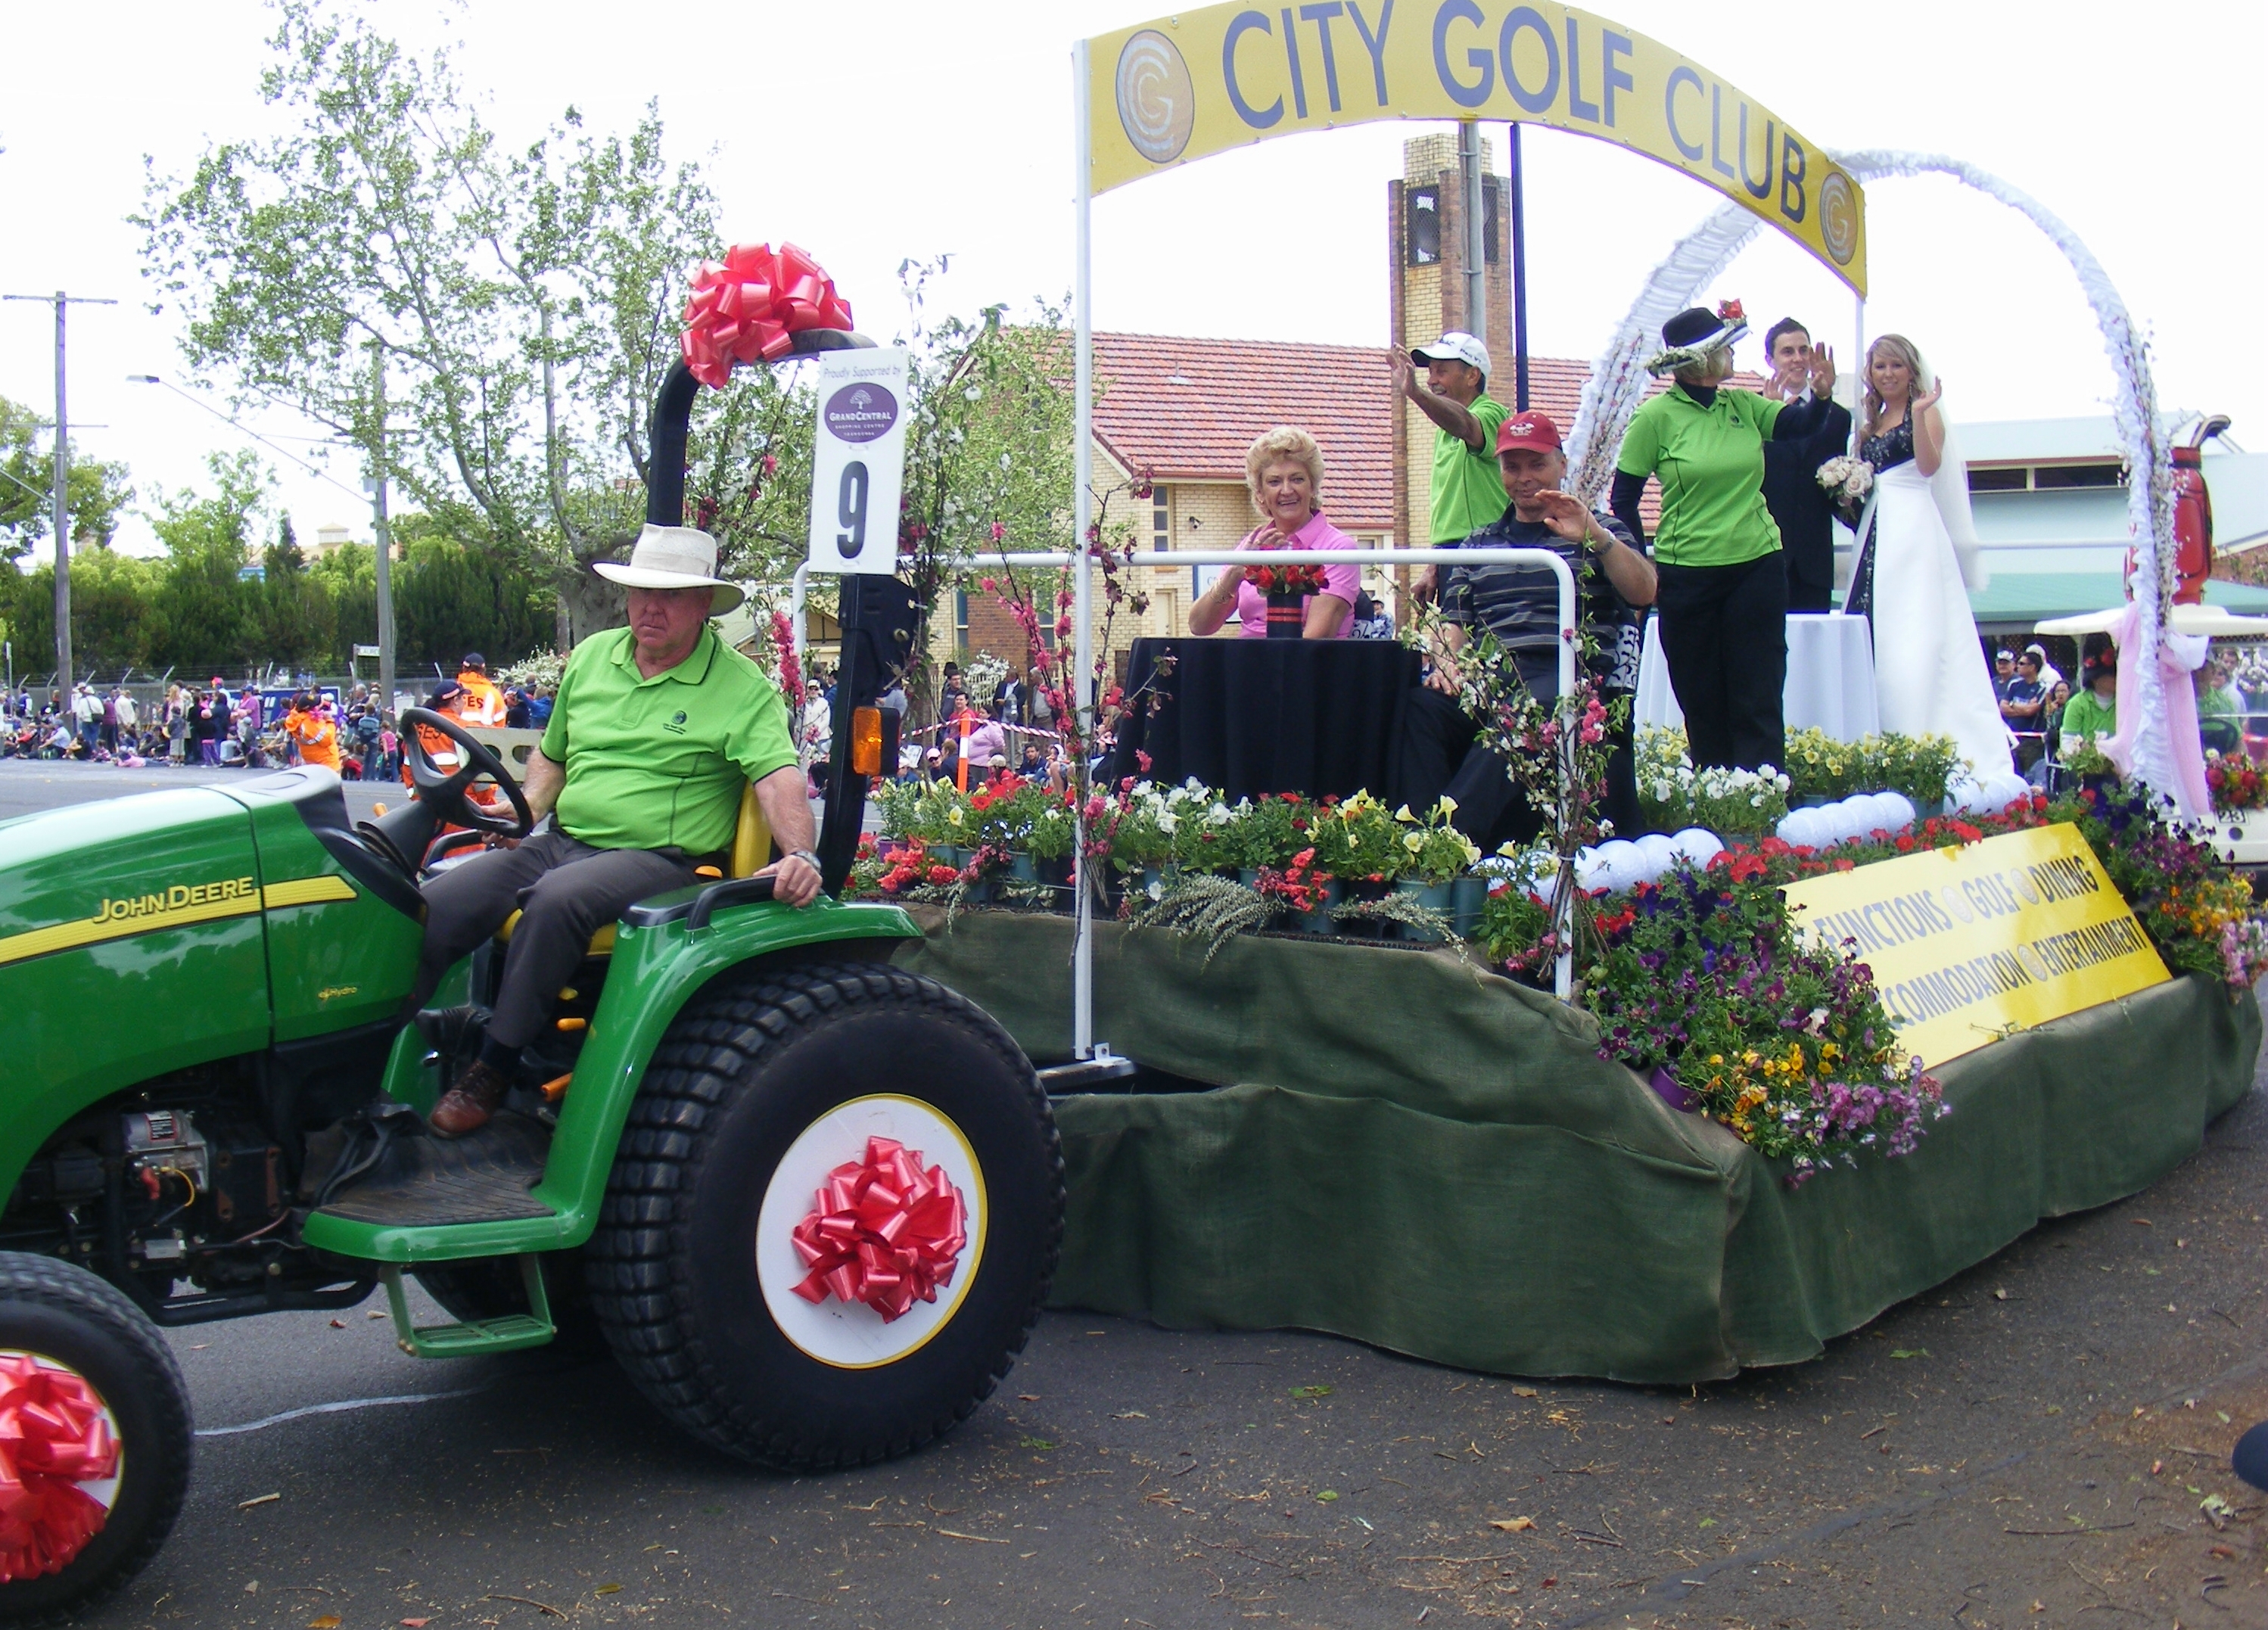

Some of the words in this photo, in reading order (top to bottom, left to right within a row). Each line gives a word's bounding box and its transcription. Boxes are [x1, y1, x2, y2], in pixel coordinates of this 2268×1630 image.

[1222, 0, 1395, 129] CITY
[1432, 0, 1634, 128] GOLF
[1666, 65, 1806, 224] CLUB
[823, 367, 849, 380] Proudly
[852, 365, 891, 380] Supported
[892, 364, 901, 378] by
[836, 460, 869, 559] 9
[92, 893, 165, 923] JOHN
[167, 876, 254, 910] DEERE
[1813, 890, 1953, 963] FUNCTIONS
[1962, 873, 2021, 919] GOLF
[2027, 855, 2099, 904] DINING
[1880, 949, 2033, 1031] COMMODATION
[2032, 915, 2148, 977] ENTERTAINMENT
